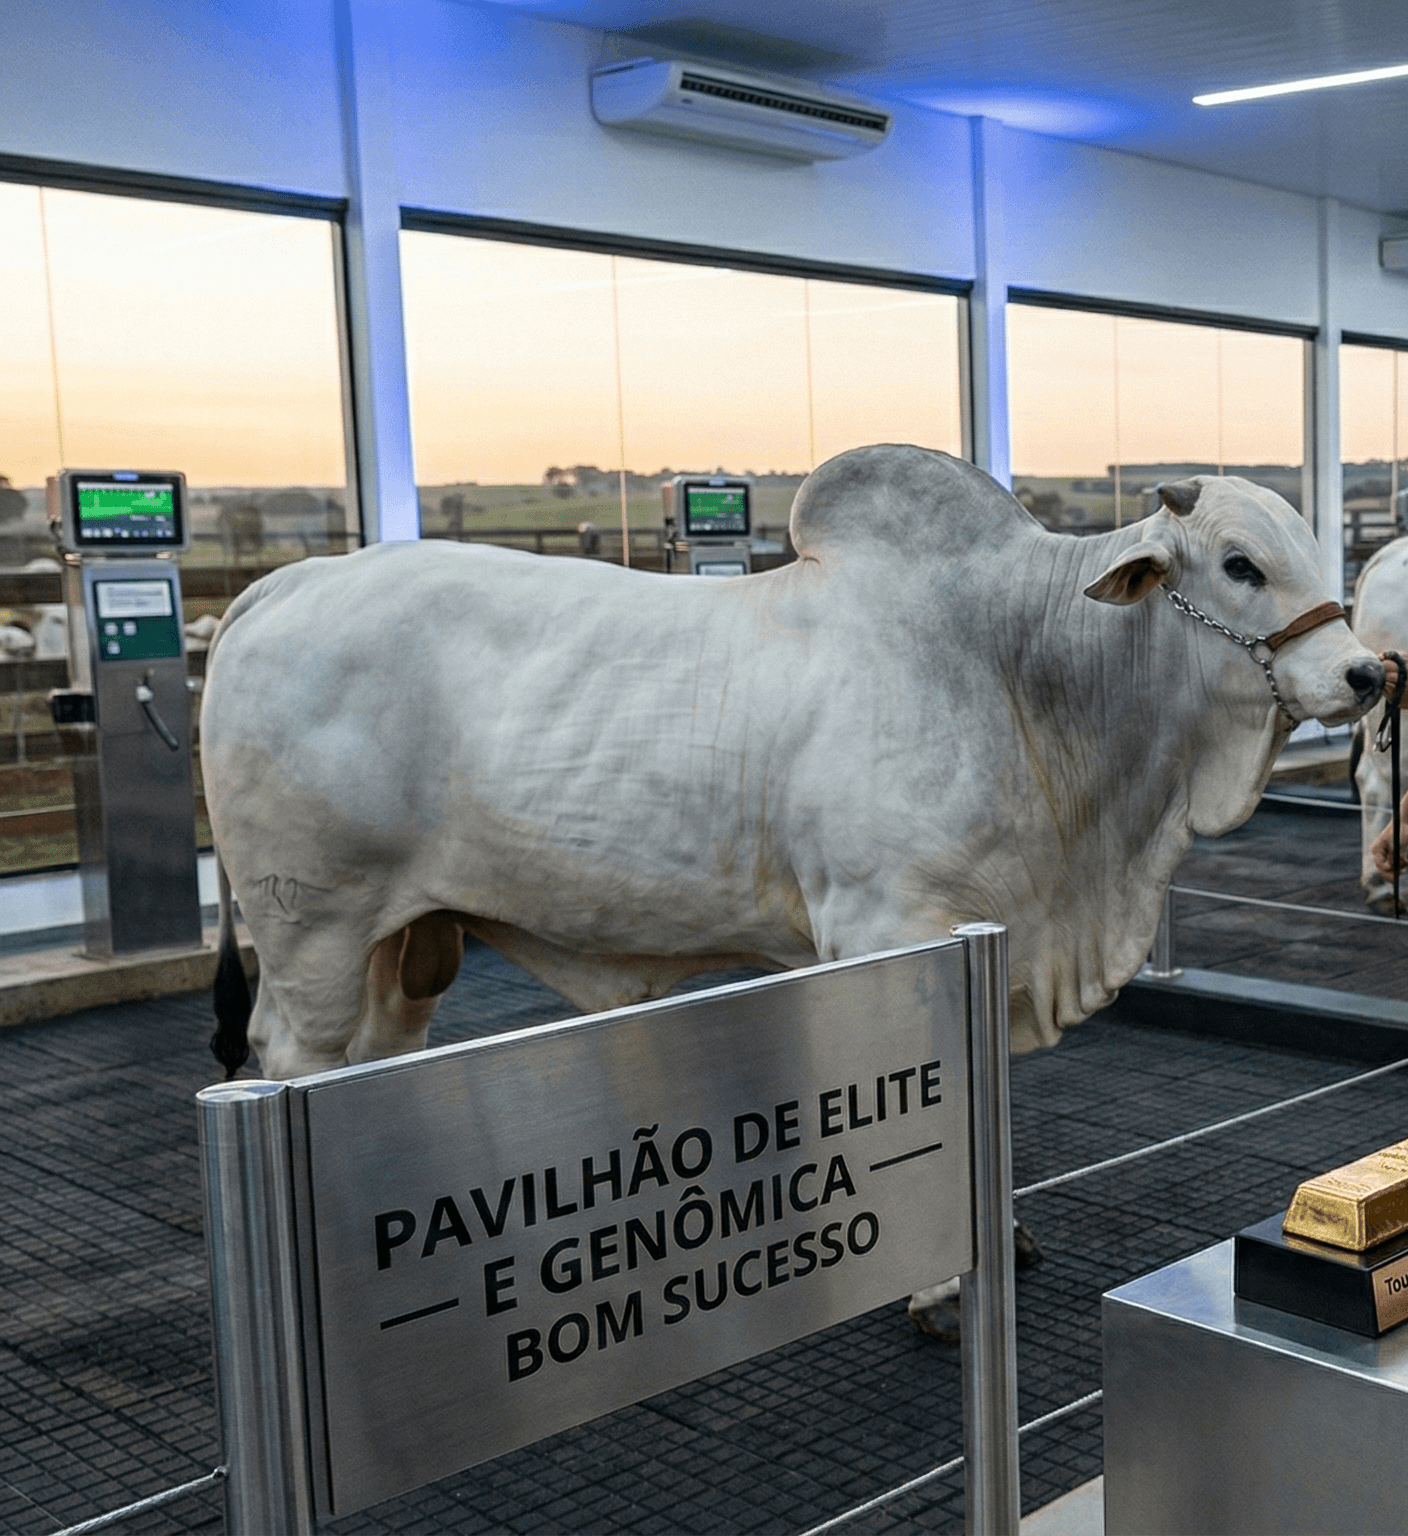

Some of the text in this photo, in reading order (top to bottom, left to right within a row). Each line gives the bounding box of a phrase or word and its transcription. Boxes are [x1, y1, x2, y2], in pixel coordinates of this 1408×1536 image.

[373, 1060, 942, 1271] PAVILHÃO DE ELITE
[484, 1154, 857, 1317] E GENÔMICA
[506, 1211, 881, 1383] BOM SUCESSO
